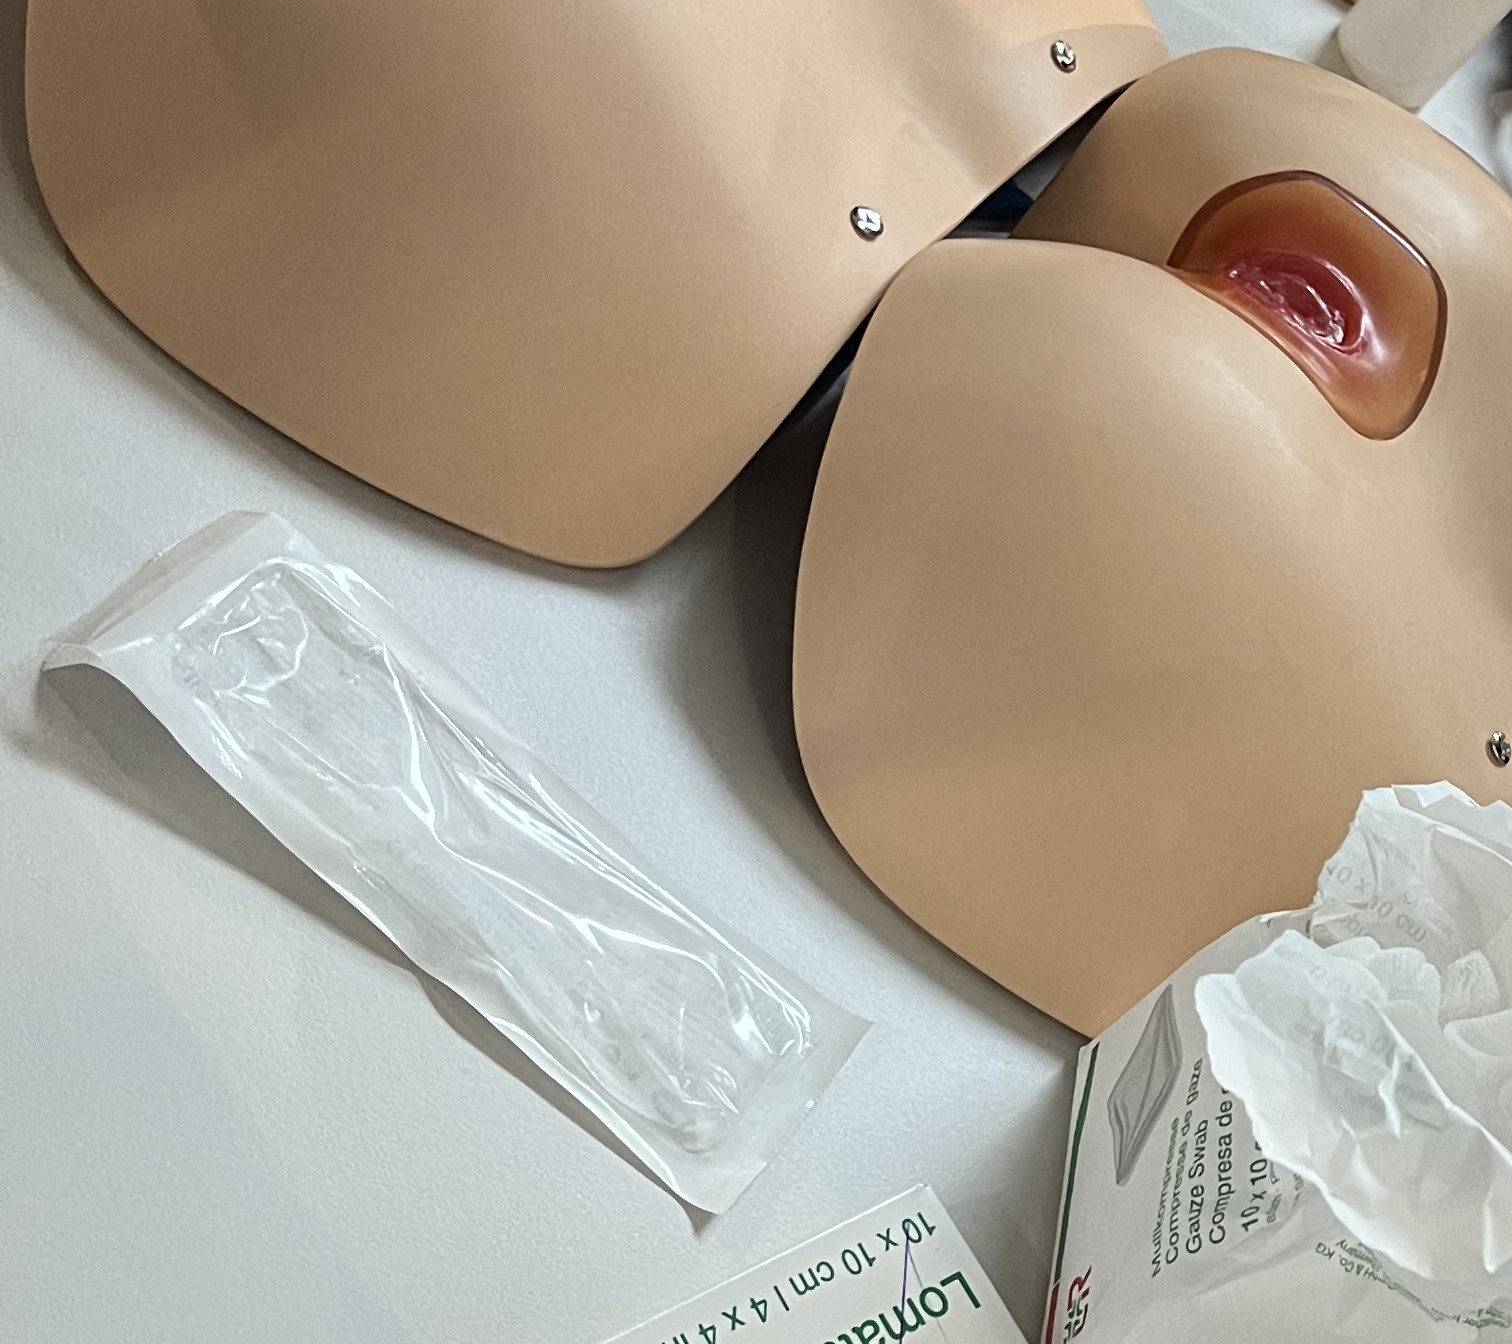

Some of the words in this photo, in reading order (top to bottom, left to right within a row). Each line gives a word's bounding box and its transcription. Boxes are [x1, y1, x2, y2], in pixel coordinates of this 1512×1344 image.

[1213, 1098, 1235, 1128] de
[1186, 1117, 1209, 1181] Swab
[1204, 1130, 1235, 1245] Compresa
[1245, 1155, 1270, 1188] 10
[1161, 1140, 1189, 1265] Compresse
[1248, 1187, 1266, 1206] x
[898, 1208, 938, 1247] 10
[1183, 1182, 1205, 1255] Gauze
[1237, 1203, 1261, 1234] 10
[838, 1239, 878, 1277] 10
[876, 1228, 898, 1254] x
[788, 1258, 838, 1300] cm
[720, 1305, 746, 1333] x
[746, 1291, 775, 1325] 4
